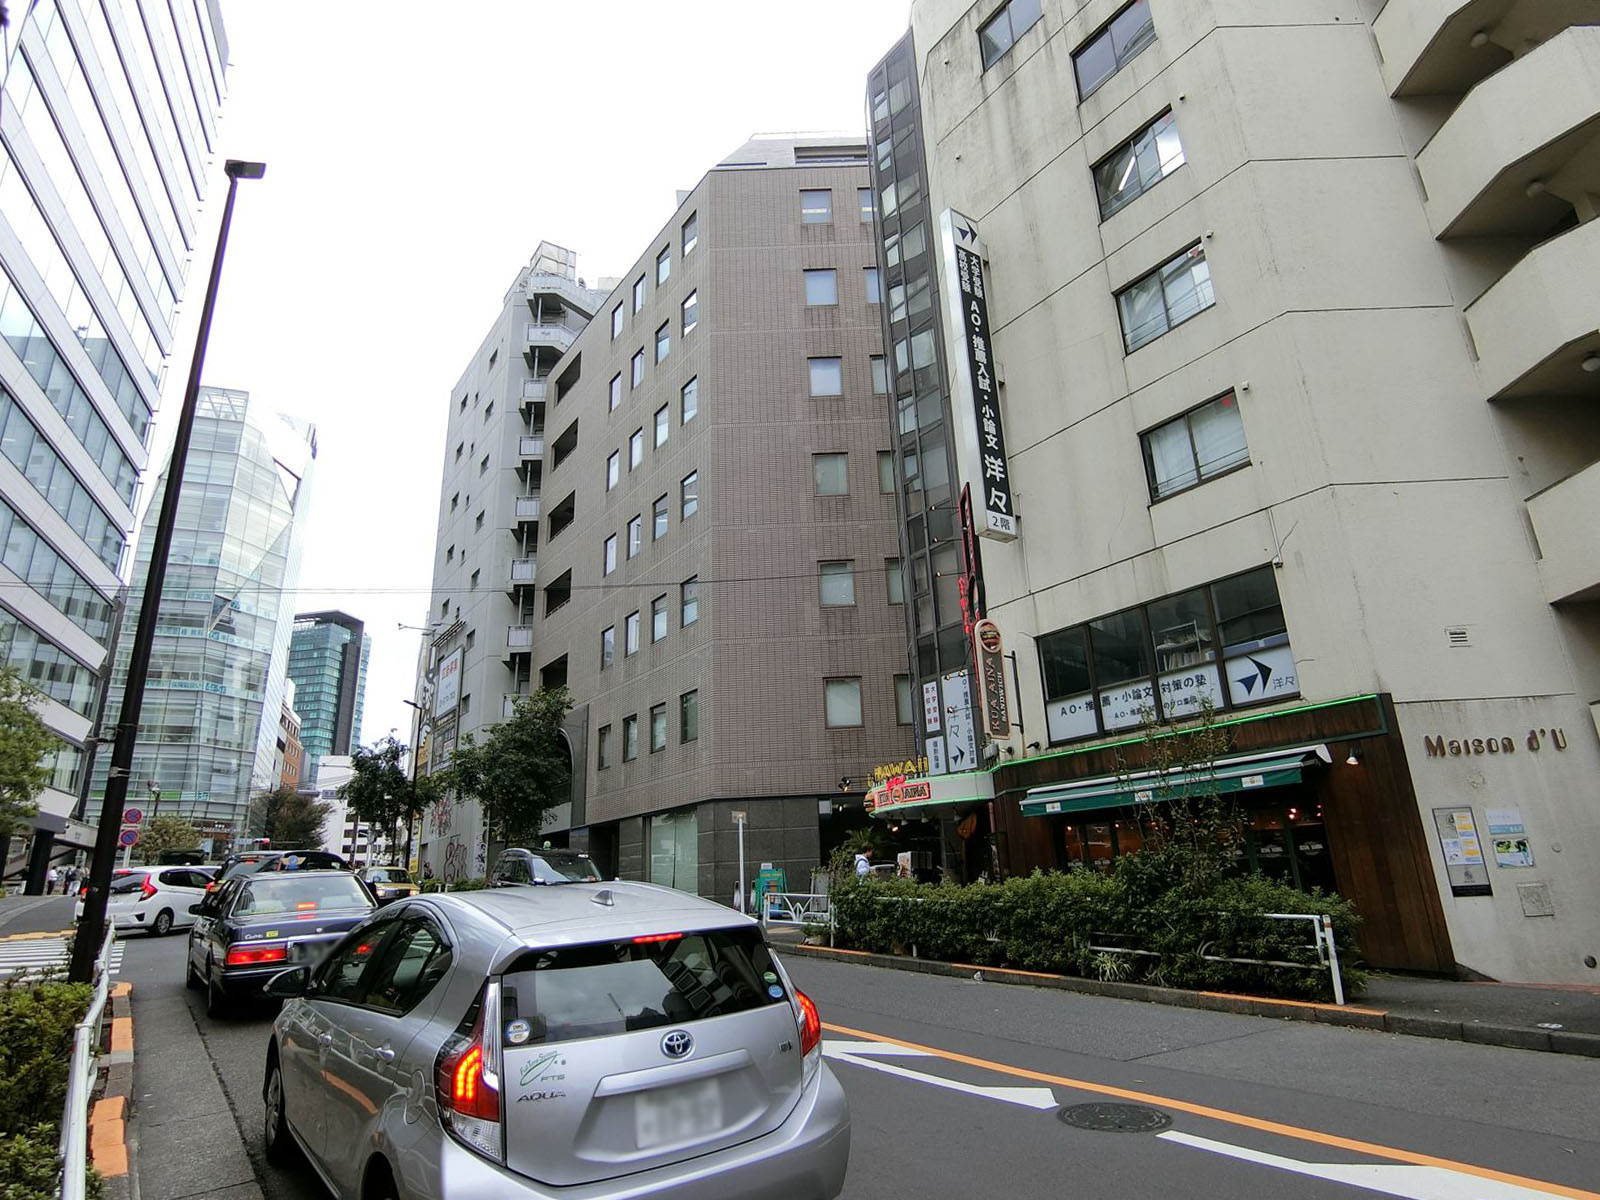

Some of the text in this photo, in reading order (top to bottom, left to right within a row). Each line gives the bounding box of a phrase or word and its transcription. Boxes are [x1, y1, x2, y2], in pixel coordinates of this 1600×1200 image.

[985, 454, 1006, 513] 洋々
[986, 656, 1001, 731] KUA AINA
[1272, 676, 1295, 691] 洋々
[1424, 734, 1515, 758] Maison
[516, 1091, 567, 1103] AQUA
